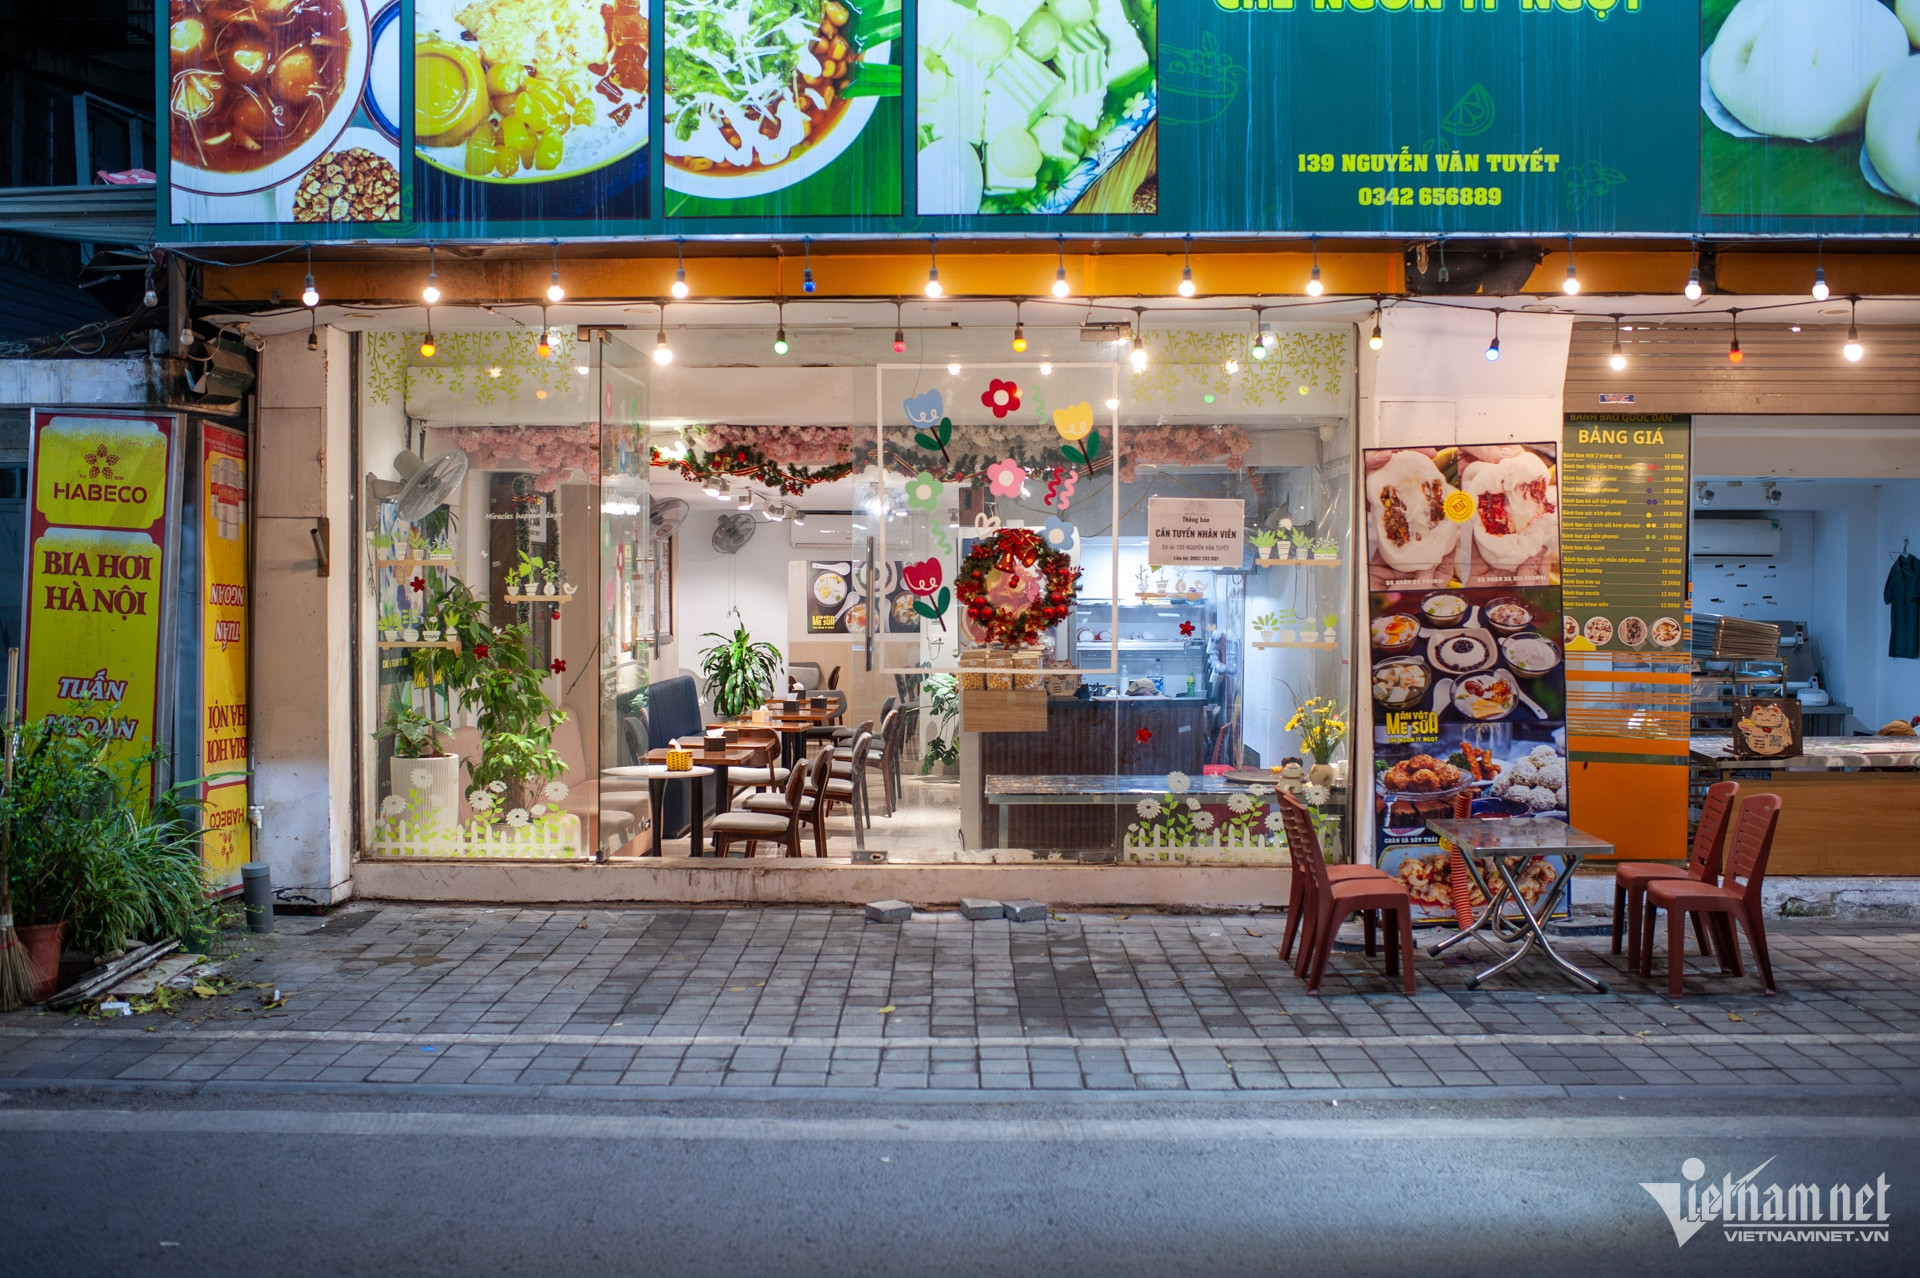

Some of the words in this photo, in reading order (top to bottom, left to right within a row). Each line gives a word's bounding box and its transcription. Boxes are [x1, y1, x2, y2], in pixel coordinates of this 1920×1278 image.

[1298, 153, 1334, 172] 139
[1341, 146, 1428, 172] NGUYỄN
[1435, 150, 1479, 172] VĂN
[1486, 147, 1559, 172] TUYẾT
[1358, 187, 1414, 206] 0342
[1418, 187, 1502, 206] 656889
[1578, 425, 1628, 444] BẢNG
[1633, 427, 1664, 444] GIÁ
[53, 482, 148, 504] HABECO
[485, 512, 514, 520] Miracles
[1197, 528, 1217, 538] NHÂN
[1220, 528, 1237, 539] VIÊN
[42, 550, 92, 577] BIA
[96, 553, 153, 580] HƠI
[44, 580, 89, 612] HÀ
[92, 584, 148, 621] NỘI
[210, 583, 245, 607] NGOAN
[214, 619, 240, 651] TUẤN
[57, 668, 128, 702] TUẤN
[208, 699, 229, 735] NỘI
[230, 703, 247, 733] HÀ
[229, 736, 247, 760] BIA
[210, 807, 244, 828] HABECO
